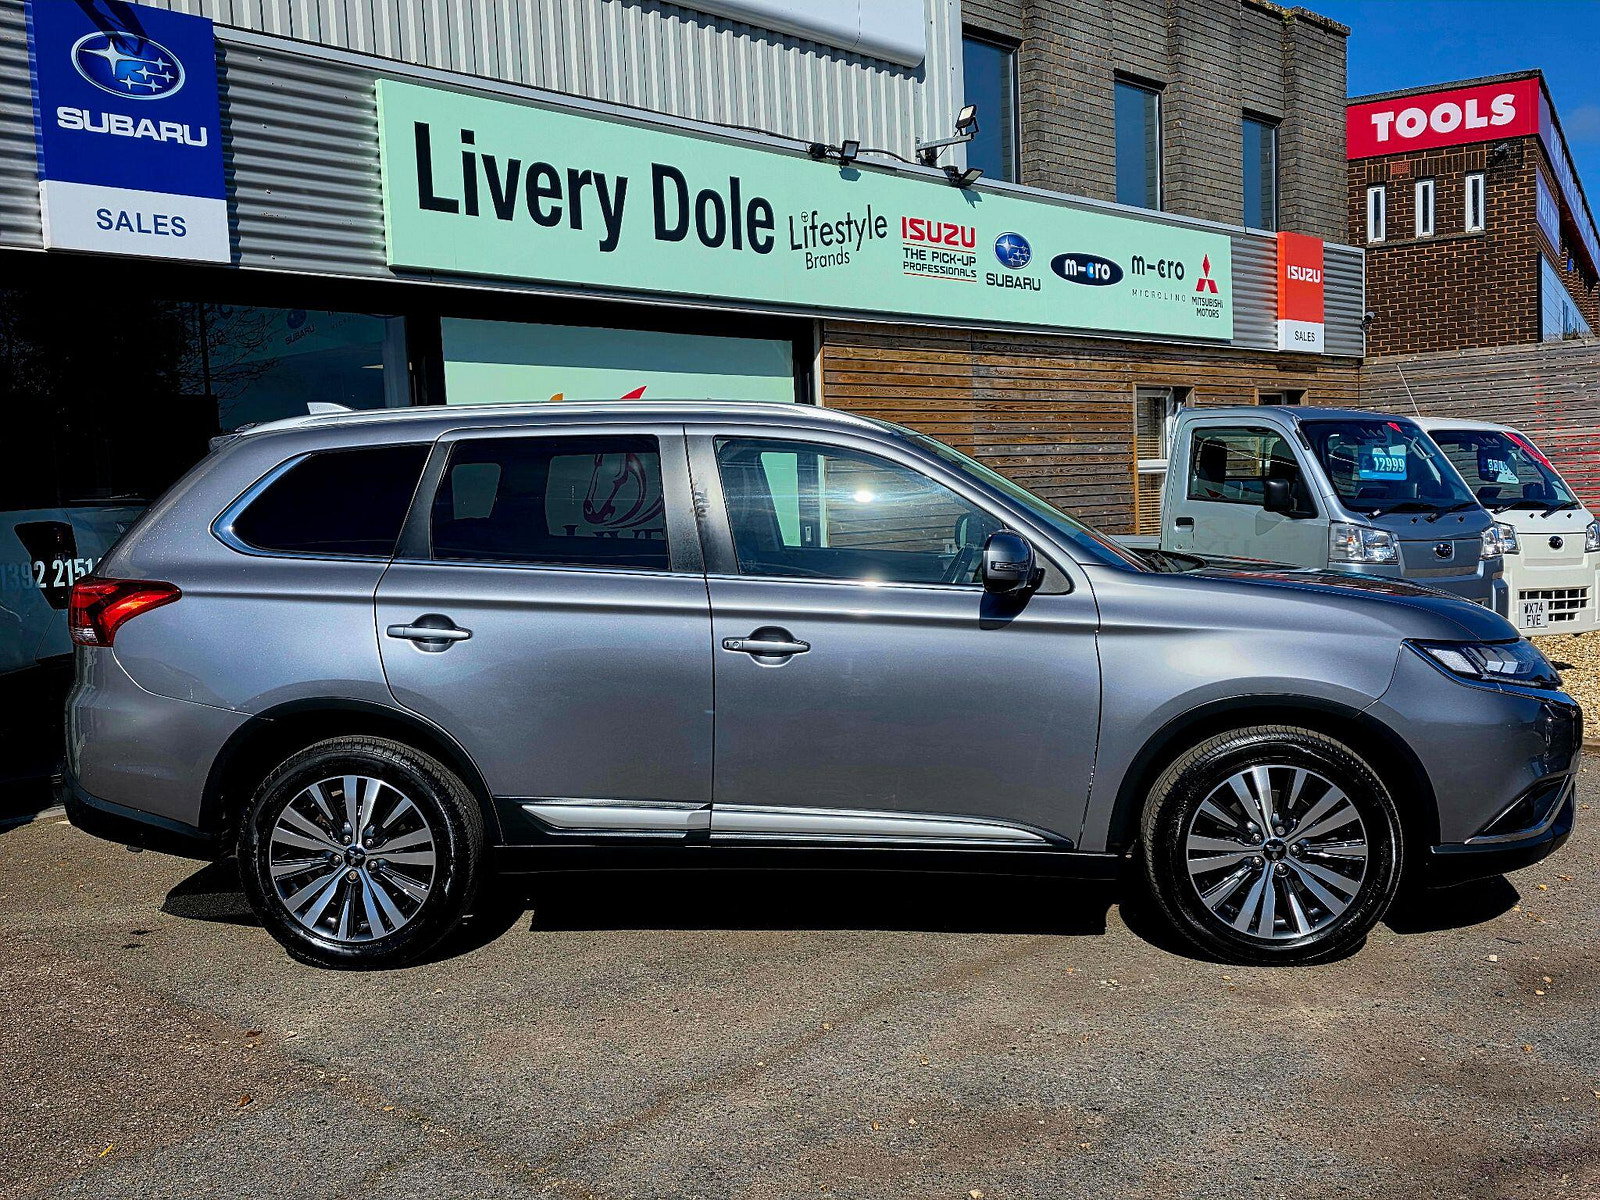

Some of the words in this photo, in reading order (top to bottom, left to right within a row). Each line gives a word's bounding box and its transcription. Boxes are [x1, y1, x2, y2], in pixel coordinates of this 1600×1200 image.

[57, 105, 208, 147] SUBARU
[1371, 93, 1517, 142] TOOLS
[414, 121, 628, 252] Livery
[651, 163, 775, 255] Dole
[96, 208, 187, 237] SALES
[789, 204, 888, 251] Lifestyle
[901, 216, 976, 248] ISUZU
[805, 246, 851, 270] Brands
[903, 247, 927, 261] THE
[931, 250, 977, 266] PICK-UP
[903, 262, 977, 278] PROFESSIONALS
[1287, 264, 1321, 284] ISUZU
[986, 272, 1041, 292] SUBARU
[1132, 288, 1187, 302] MICROLINO
[1191, 296, 1224, 309] MITSUBISHI
[1196, 307, 1220, 319] MOTORS
[1294, 329, 1316, 342] SALES
[1526, 614, 1542, 626] FVE
